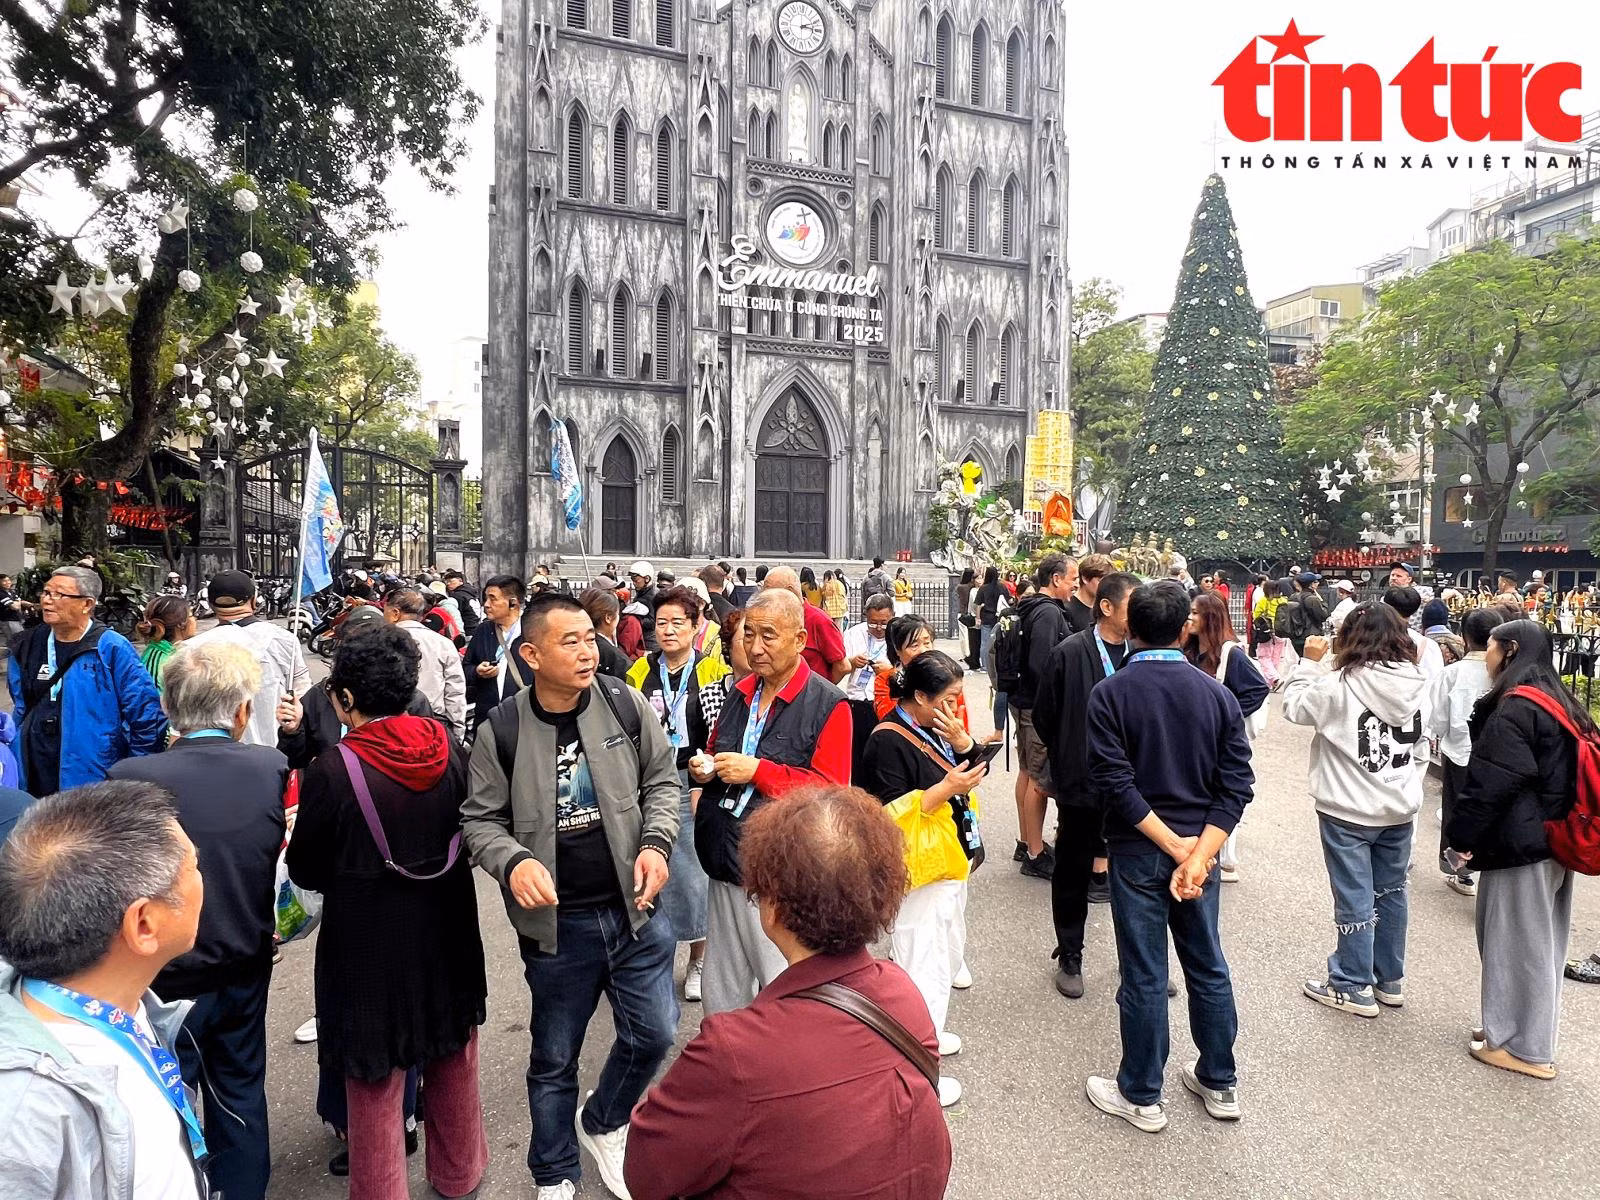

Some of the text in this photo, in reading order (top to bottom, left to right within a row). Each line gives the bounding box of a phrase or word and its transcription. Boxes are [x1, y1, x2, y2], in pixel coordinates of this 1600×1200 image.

[717, 235, 879, 297] Emmanuel
[870, 308, 883, 322] TA
[844, 324, 884, 342] 2025
[570, 813, 590, 826] SHUI
